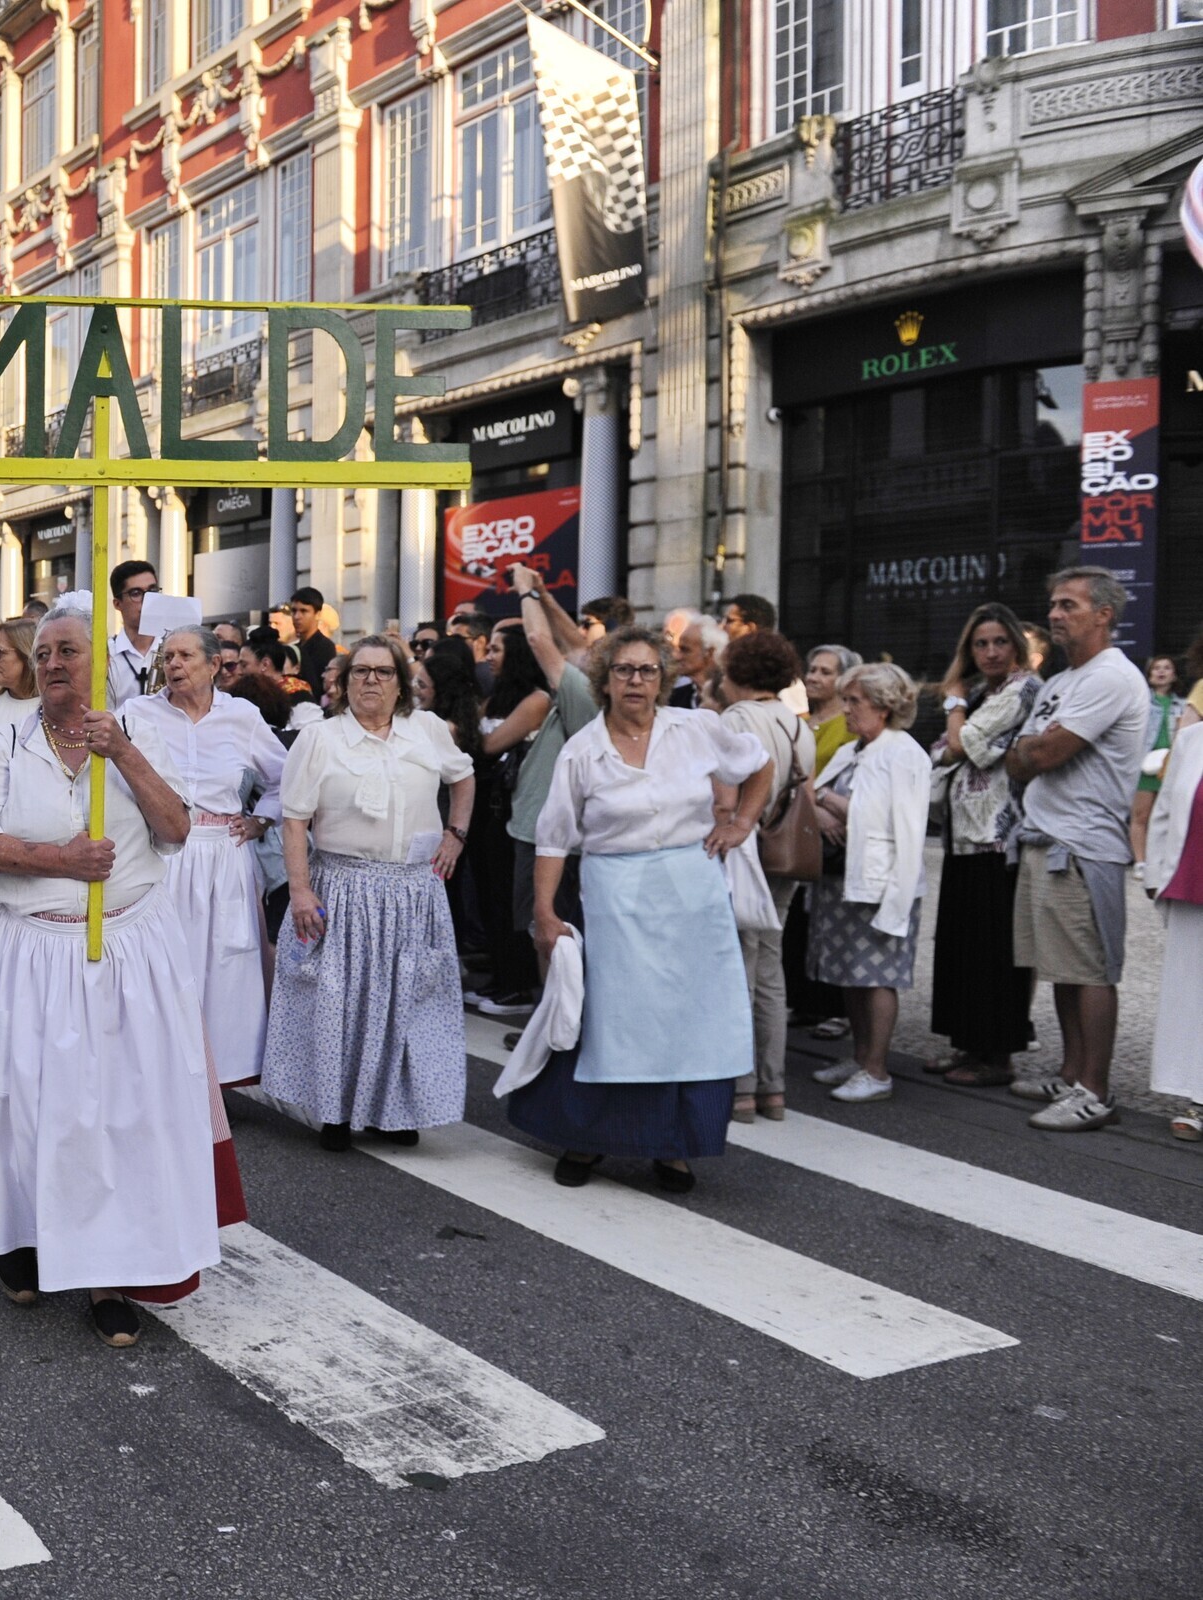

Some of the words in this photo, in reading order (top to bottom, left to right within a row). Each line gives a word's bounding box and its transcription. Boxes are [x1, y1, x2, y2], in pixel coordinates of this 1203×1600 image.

[569, 263, 642, 292] MARCOLINO
[862, 341, 959, 380] ROLEX
[472, 409, 556, 442] MARCOLINO
[1082, 429, 1132, 447] EX
[1082, 445, 1134, 463] PO
[1080, 471, 1159, 497] ÇÃO
[216, 495, 252, 513] OMEGA
[461, 515, 536, 544] EXPO
[1082, 526, 1127, 542] LA
[461, 534, 536, 563] SIÇÃO
